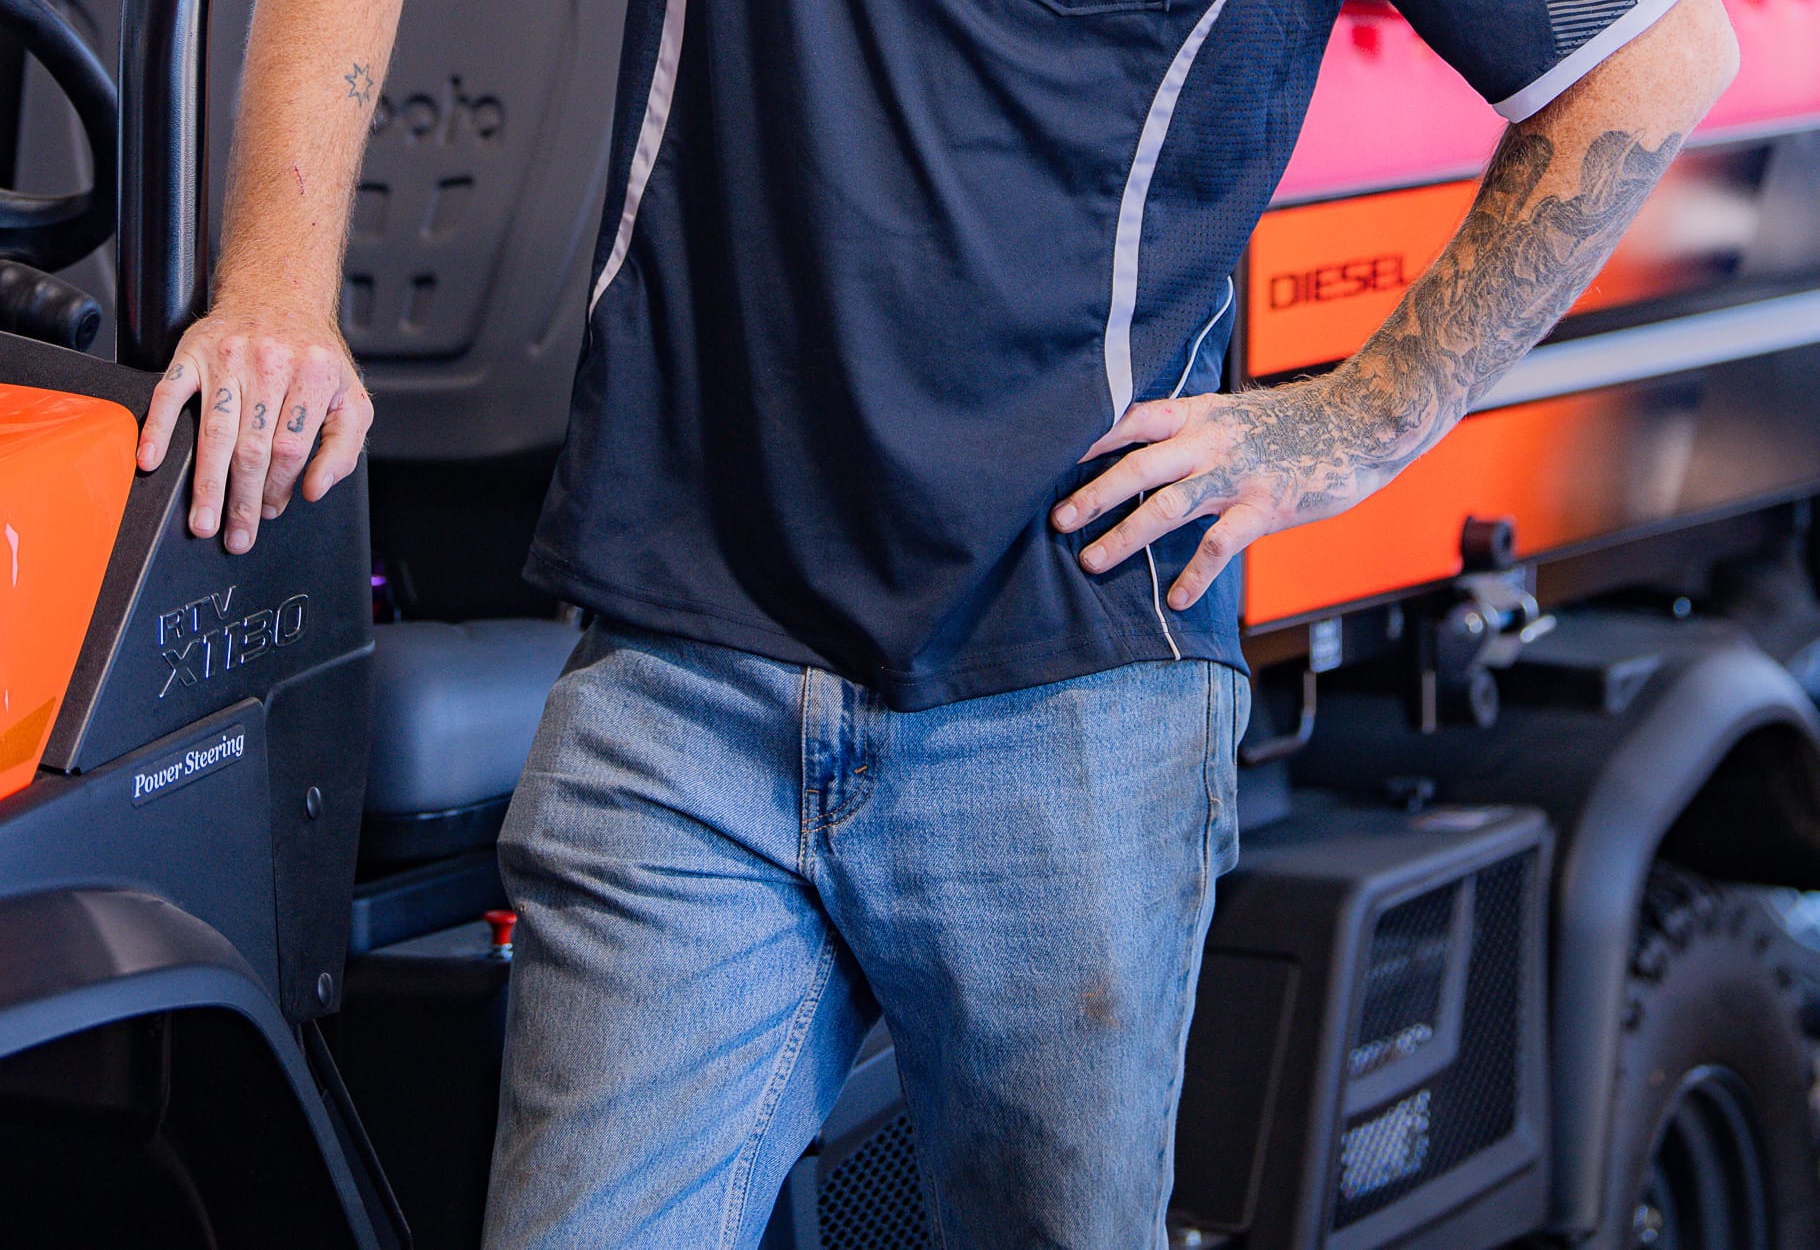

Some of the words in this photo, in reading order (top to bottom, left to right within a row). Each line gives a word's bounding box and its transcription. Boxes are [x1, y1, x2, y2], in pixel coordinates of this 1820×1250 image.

[1271, 255, 1410, 309] DIESEL
[158, 586, 236, 647] RTV
[158, 593, 309, 699] X1130
[134, 761, 183, 798] Power
[184, 733, 245, 775] Steering
